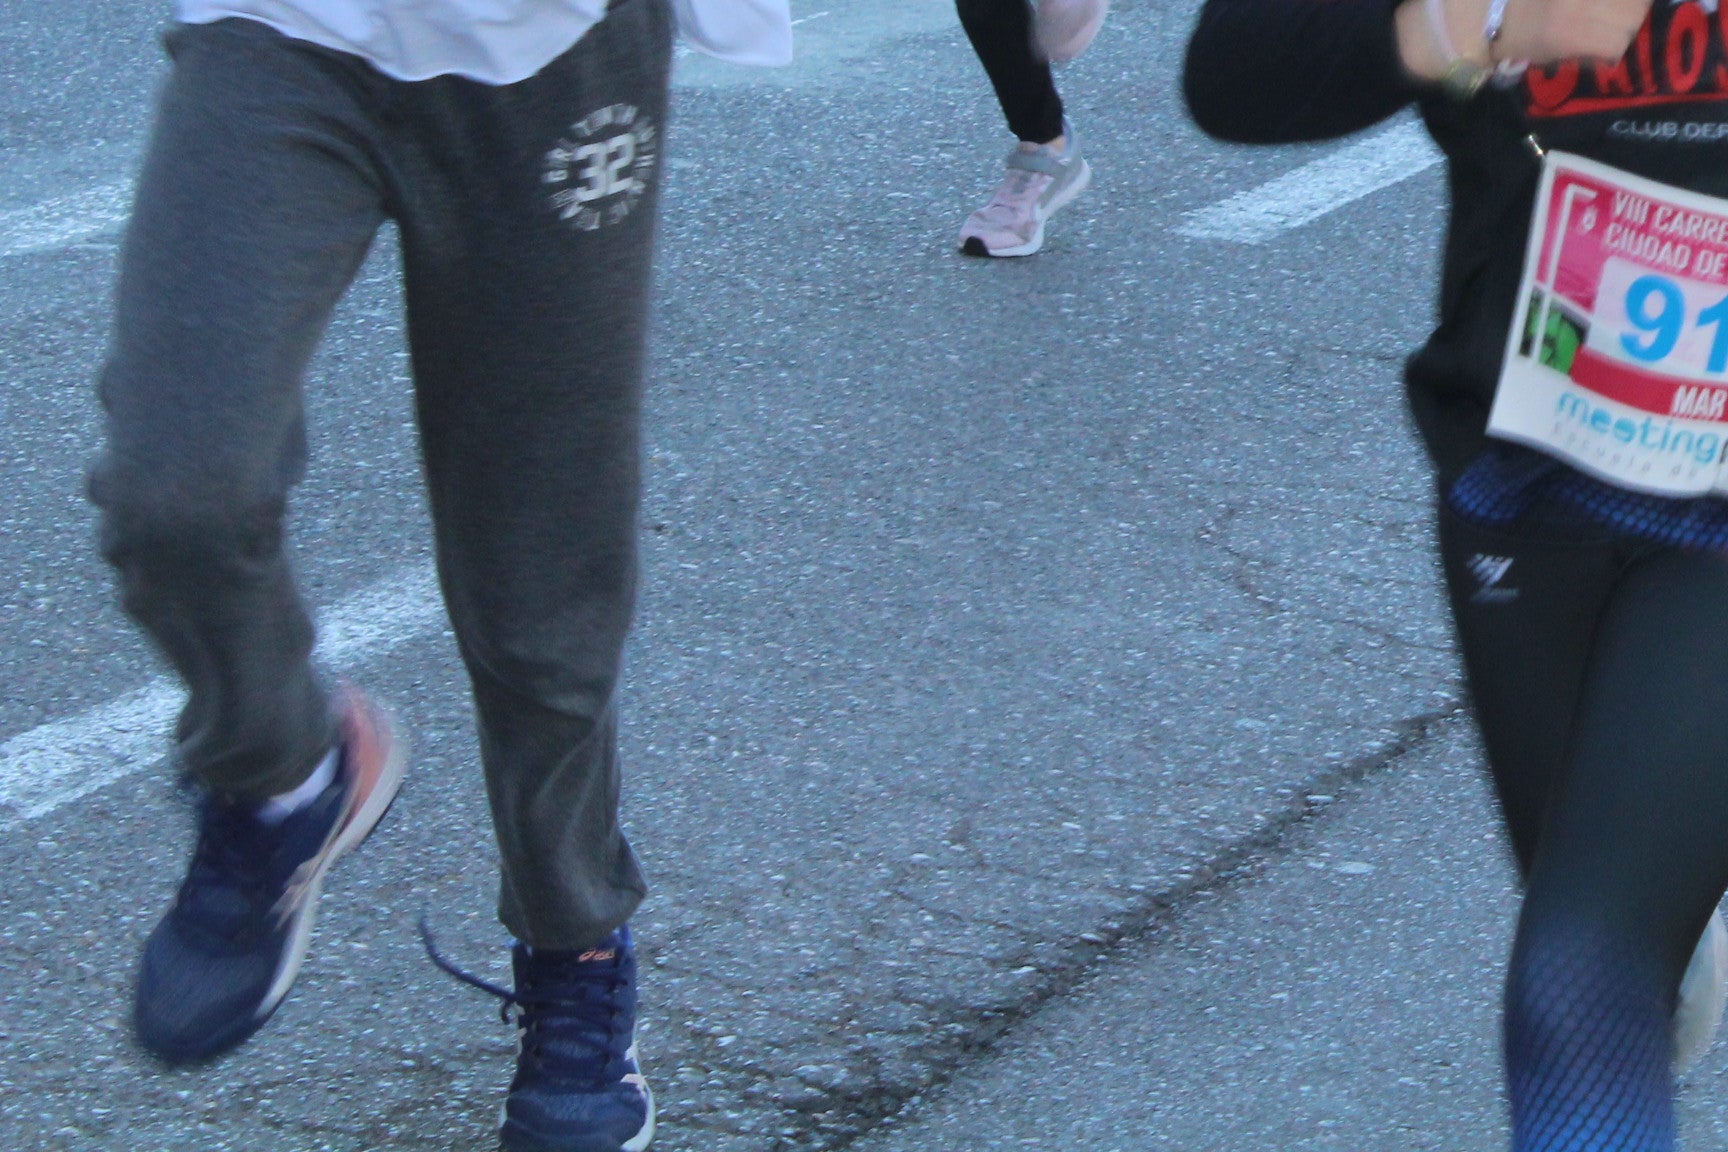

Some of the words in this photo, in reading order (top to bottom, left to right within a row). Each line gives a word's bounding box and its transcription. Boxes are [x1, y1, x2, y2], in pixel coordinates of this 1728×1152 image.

[1609, 119, 1677, 139] CLUB
[572, 132, 636, 203] 32
[1609, 190, 1651, 224] VIII
[1603, 221, 1693, 270] CIUDAD
[1697, 251, 1728, 276] DE
[1669, 384, 1728, 420] MAR
